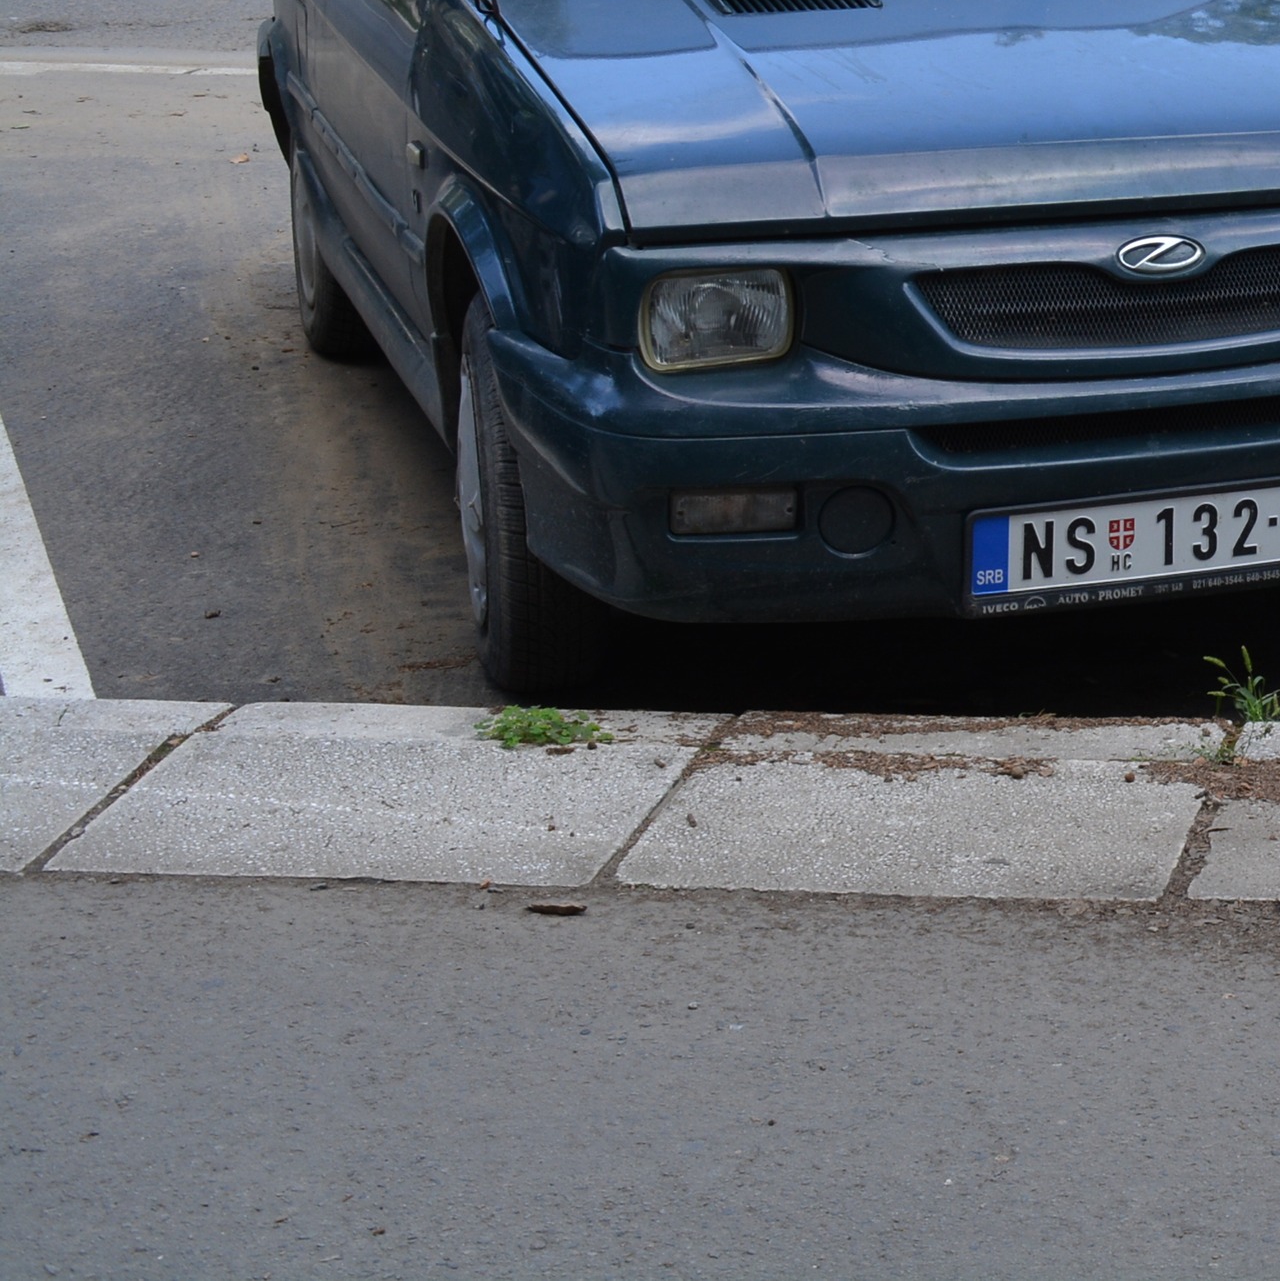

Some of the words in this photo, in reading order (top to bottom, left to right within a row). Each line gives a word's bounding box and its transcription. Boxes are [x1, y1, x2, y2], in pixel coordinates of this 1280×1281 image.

[1021, 516, 1096, 582] NS
[976, 569, 1004, 586] SRB
[982, 601, 1019, 614] IVECO
[1056, 592, 1089, 606] AUTO
[1097, 585, 1144, 601] PROMET
